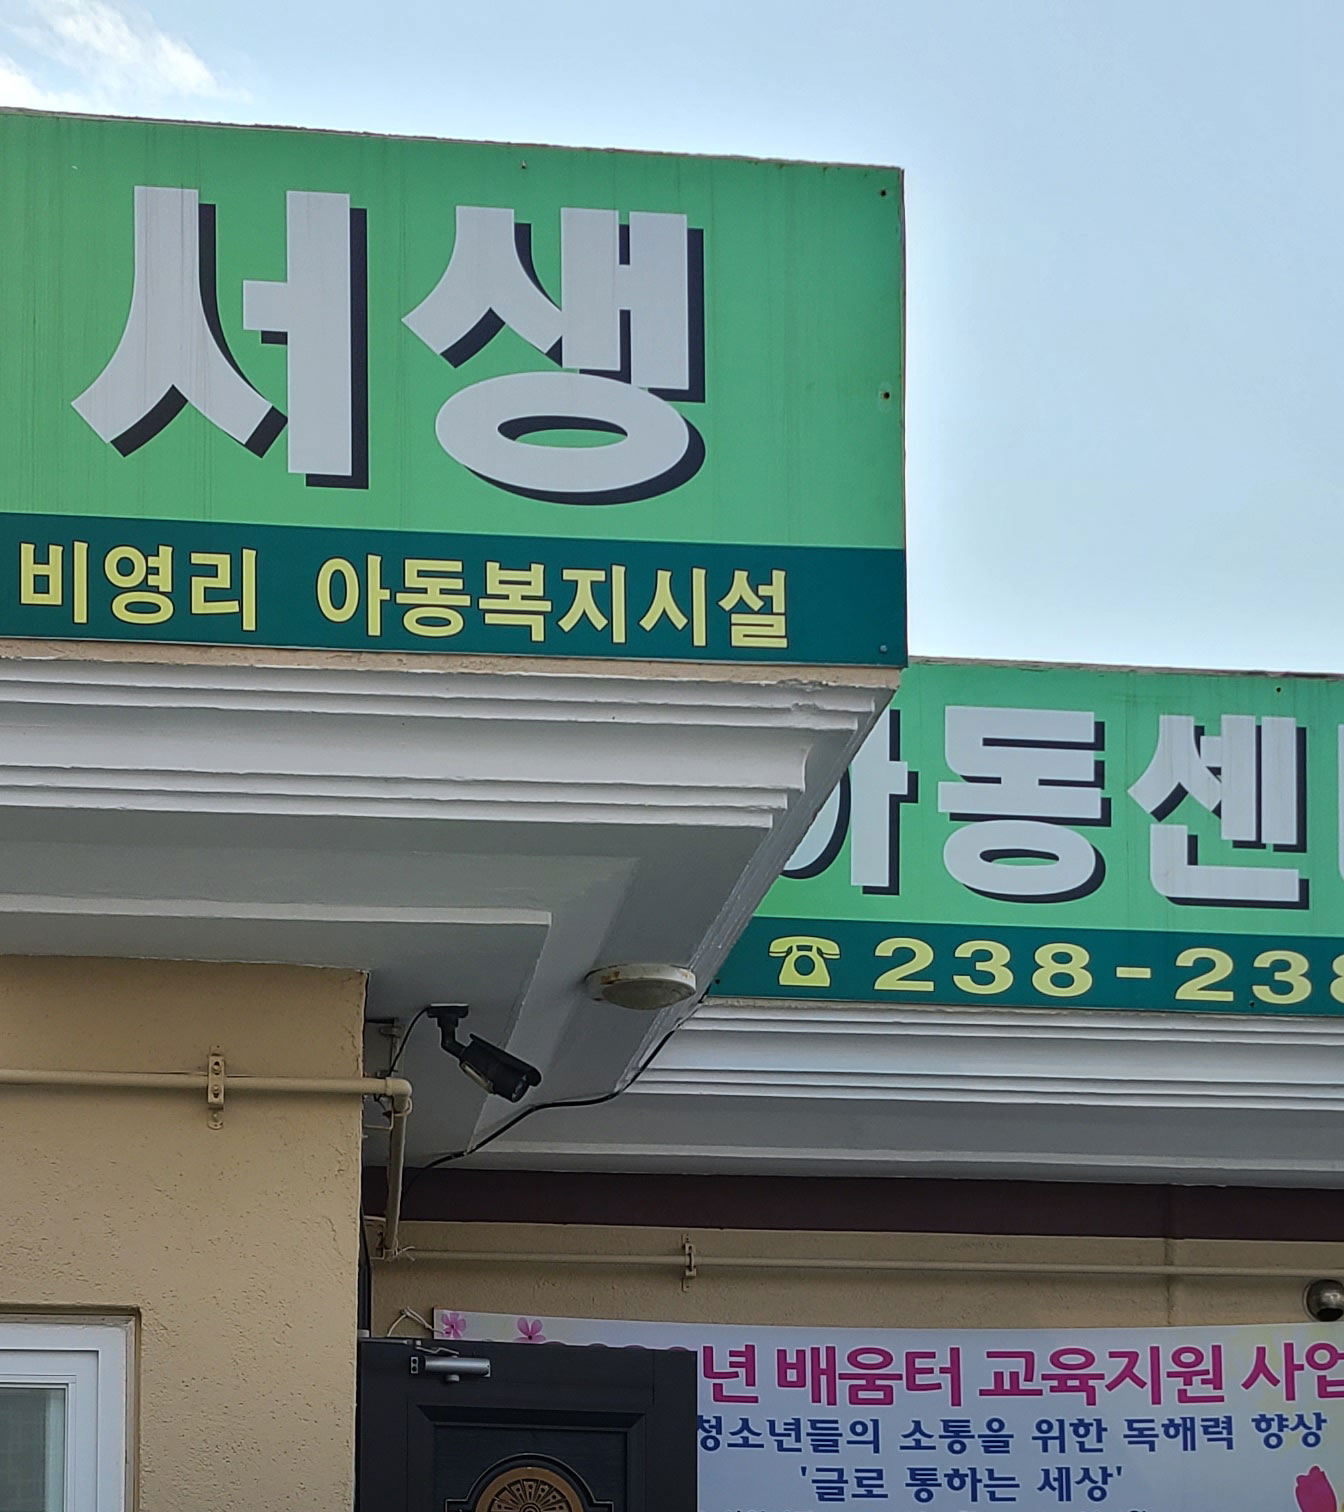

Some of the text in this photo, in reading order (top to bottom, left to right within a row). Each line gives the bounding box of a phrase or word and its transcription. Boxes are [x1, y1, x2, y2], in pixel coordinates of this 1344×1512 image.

[70, 184, 706, 506] 서생
[18, 539, 789, 649] 비영리 아동복지시설
[775, 1344, 962, 1407] 배움터
[978, 1343, 1226, 1407] 교육지원
[898, 1416, 1015, 1455] 소통을
[1031, 1416, 1109, 1454] 위한
[1122, 1414, 1235, 1453] 독해력
[1250, 1410, 1328, 1450] 향상
[904, 1465, 1021, 1503] 통하는
